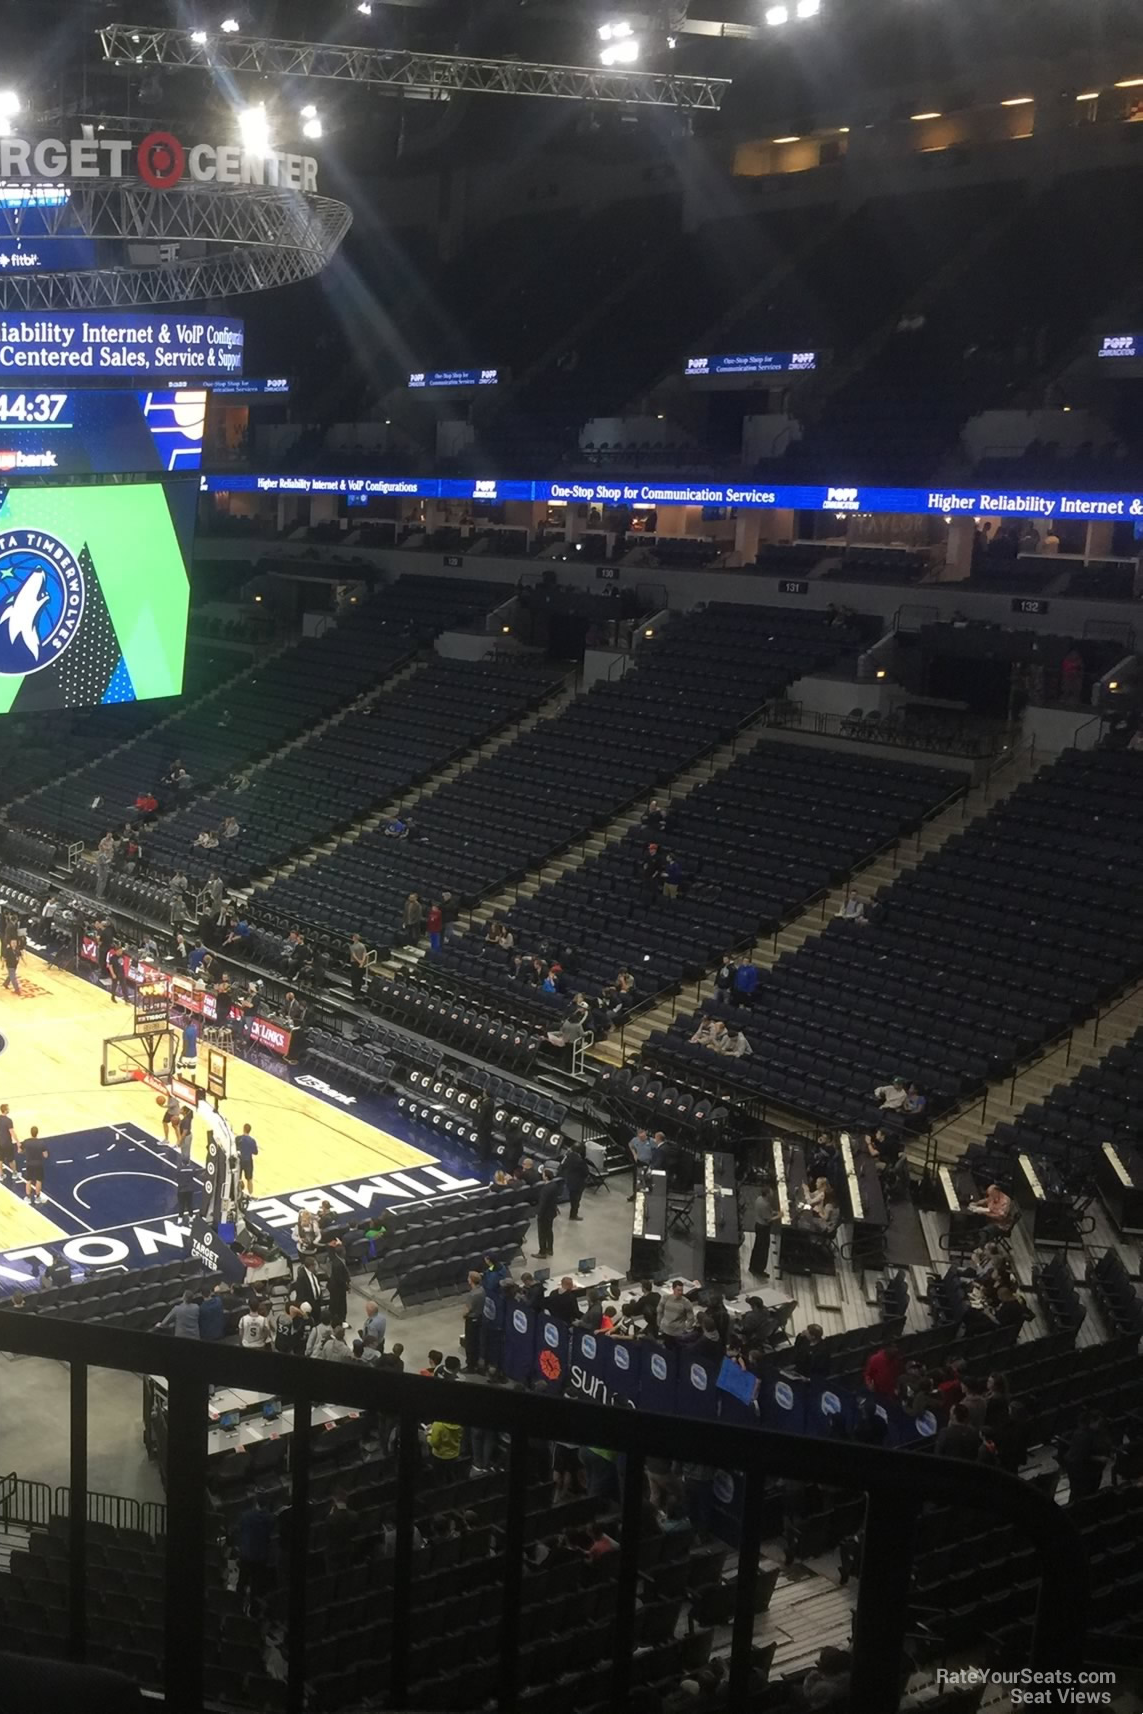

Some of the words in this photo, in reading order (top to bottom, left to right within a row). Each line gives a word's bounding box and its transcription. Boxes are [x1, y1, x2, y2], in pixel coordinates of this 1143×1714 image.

[188, 142, 319, 192] CENTER
[11, 253, 41, 267] fitbit
[82, 324, 154, 343] Internet
[159, 323, 171, 343] &
[176, 324, 204, 344] VoIP
[1103, 337, 1133, 349] POPP
[8, 346, 94, 367] Centered
[99, 347, 150, 369] Sales,
[155, 346, 204, 367] Service
[207, 347, 216, 367] &
[257, 478, 278, 489] Higher
[279, 478, 311, 491] Reliability
[312, 479, 337, 490] Internet
[339, 480, 346, 490] &
[348, 480, 364, 491] VoIP
[366, 480, 417, 493] Configurations
[476, 480, 496, 492] POPP
[551, 485, 594, 500] One-Stop
[596, 486, 621, 501] Shop
[623, 486, 638, 499] for
[641, 487, 724, 502] Communication
[725, 488, 775, 503] Services
[827, 487, 858, 501] POPP
[927, 494, 976, 512] Higher
[979, 494, 1055, 515] Reliability
[1060, 496, 1124, 514] Internet
[1129, 498, 1143, 515] &
[602, 569, 614, 578] 130
[26, 534, 80, 649] TIMBERWOLVES
[785, 583, 799, 593] 131
[1020, 601, 1039, 612] 132
[410, 1072, 419, 1081] G
[421, 1077, 430, 1087] G
[433, 1083, 442, 1093] G
[445, 1088, 454, 1098] G
[398, 1098, 406, 1106] G
[457, 1093, 467, 1104] G
[470, 1099, 478, 1109] G
[409, 1104, 417, 1112] G
[421, 1109, 429, 1118] G
[433, 1115, 441, 1123] G
[495, 1110, 505, 1121] G
[445, 1121, 453, 1130] G
[522, 1122, 531, 1133] G
[457, 1127, 466, 1136] G
[535, 1127, 545, 1138] G
[470, 1133, 478, 1142] G
[550, 1134, 560, 1145] G
[497, 1145, 505, 1154] G
[193, 1238, 219, 1263] TARGET
[278, 1325, 289, 1335] 32
[571, 1365, 608, 1405] sun
